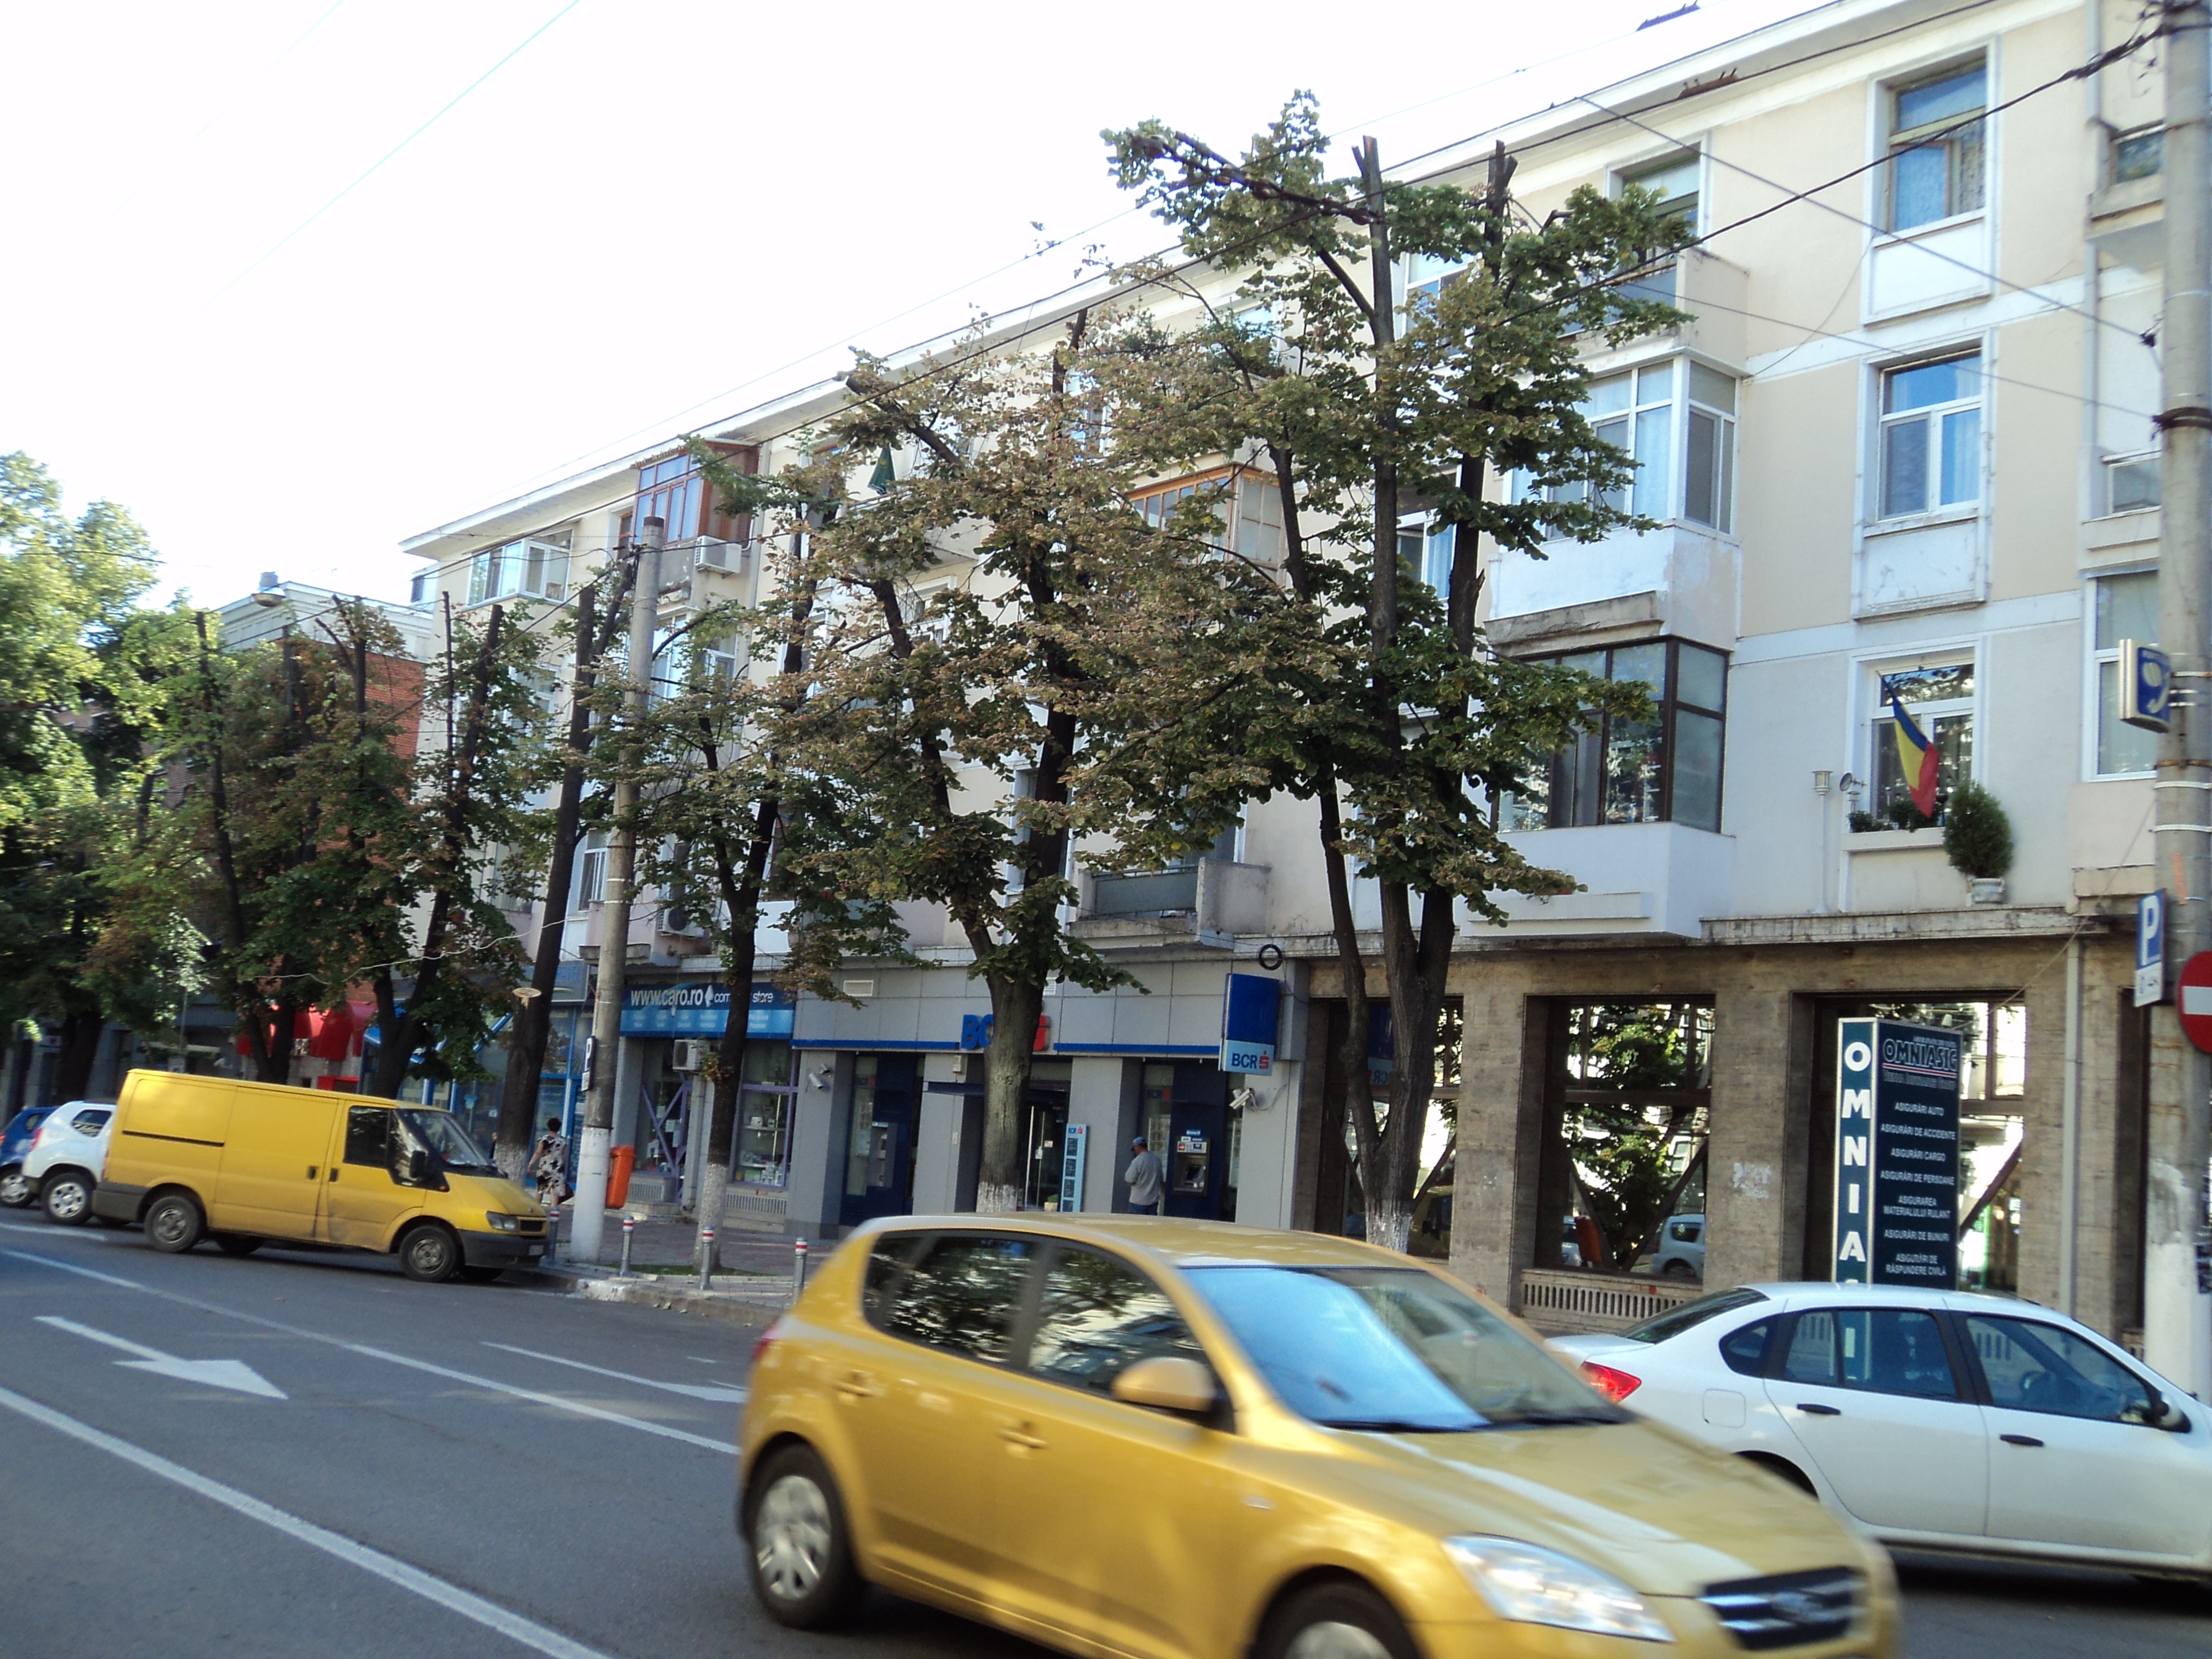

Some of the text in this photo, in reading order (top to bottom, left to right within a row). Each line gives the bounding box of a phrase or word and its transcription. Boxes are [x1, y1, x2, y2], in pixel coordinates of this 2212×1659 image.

[2141, 895, 2160, 966] P
[631, 989, 703, 1006] www.caro.ro
[752, 990, 774, 1003] store
[961, 1014, 994, 1050] BC
[584, 1037, 592, 1072] P
[1231, 1053, 1258, 1069] BCR
[1882, 1038, 1958, 1072] OMNIASIG
[1928, 1106, 1944, 1116] AUTO
[1914, 1127, 1923, 1136] DE
[1923, 1128, 1957, 1140] ACCIDENTE
[1839, 1041, 1871, 1284] OMNIA
[1924, 1151, 1946, 1162] CARGO
[1914, 1173, 1923, 1183] DE
[1918, 1231, 1927, 1240] DE
[1929, 1255, 1938, 1264] DE
